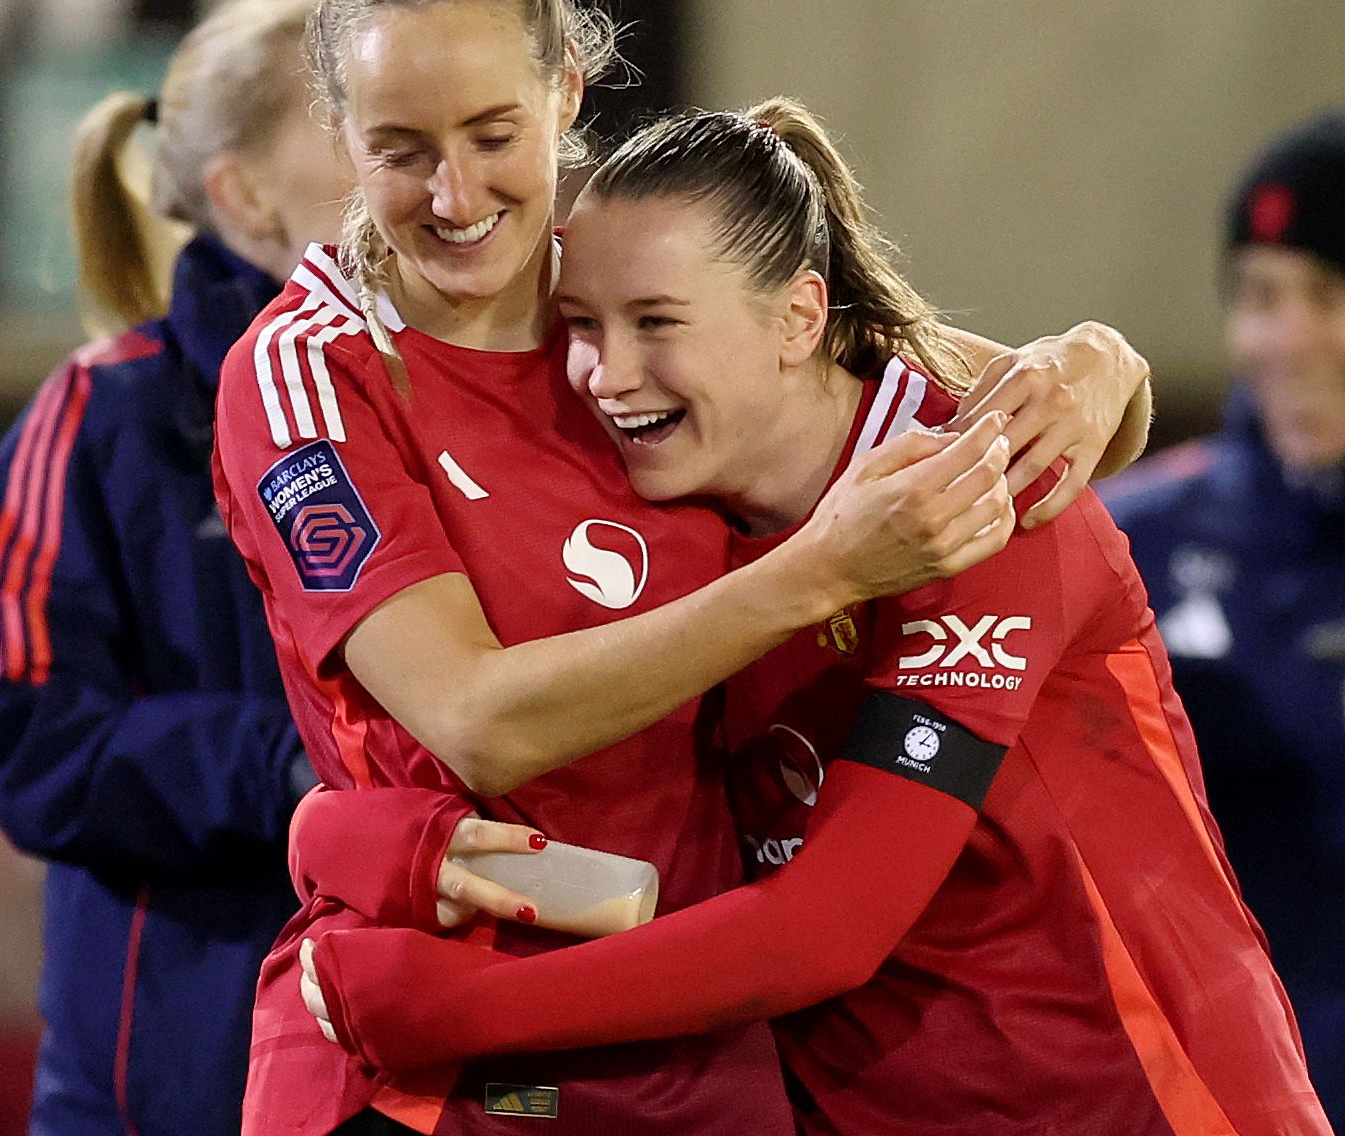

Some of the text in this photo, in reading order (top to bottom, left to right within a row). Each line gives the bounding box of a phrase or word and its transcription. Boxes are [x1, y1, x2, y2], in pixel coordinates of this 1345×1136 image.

[269, 464, 332, 513] WOMEN'S
[270, 451, 326, 492] BARCLAYS
[275, 475, 338, 523] SUPER LEAGUE
[898, 614, 1032, 671] DXC
[896, 671, 1022, 691] TECHNOLOGY
[895, 755, 931, 773] MUNICH
